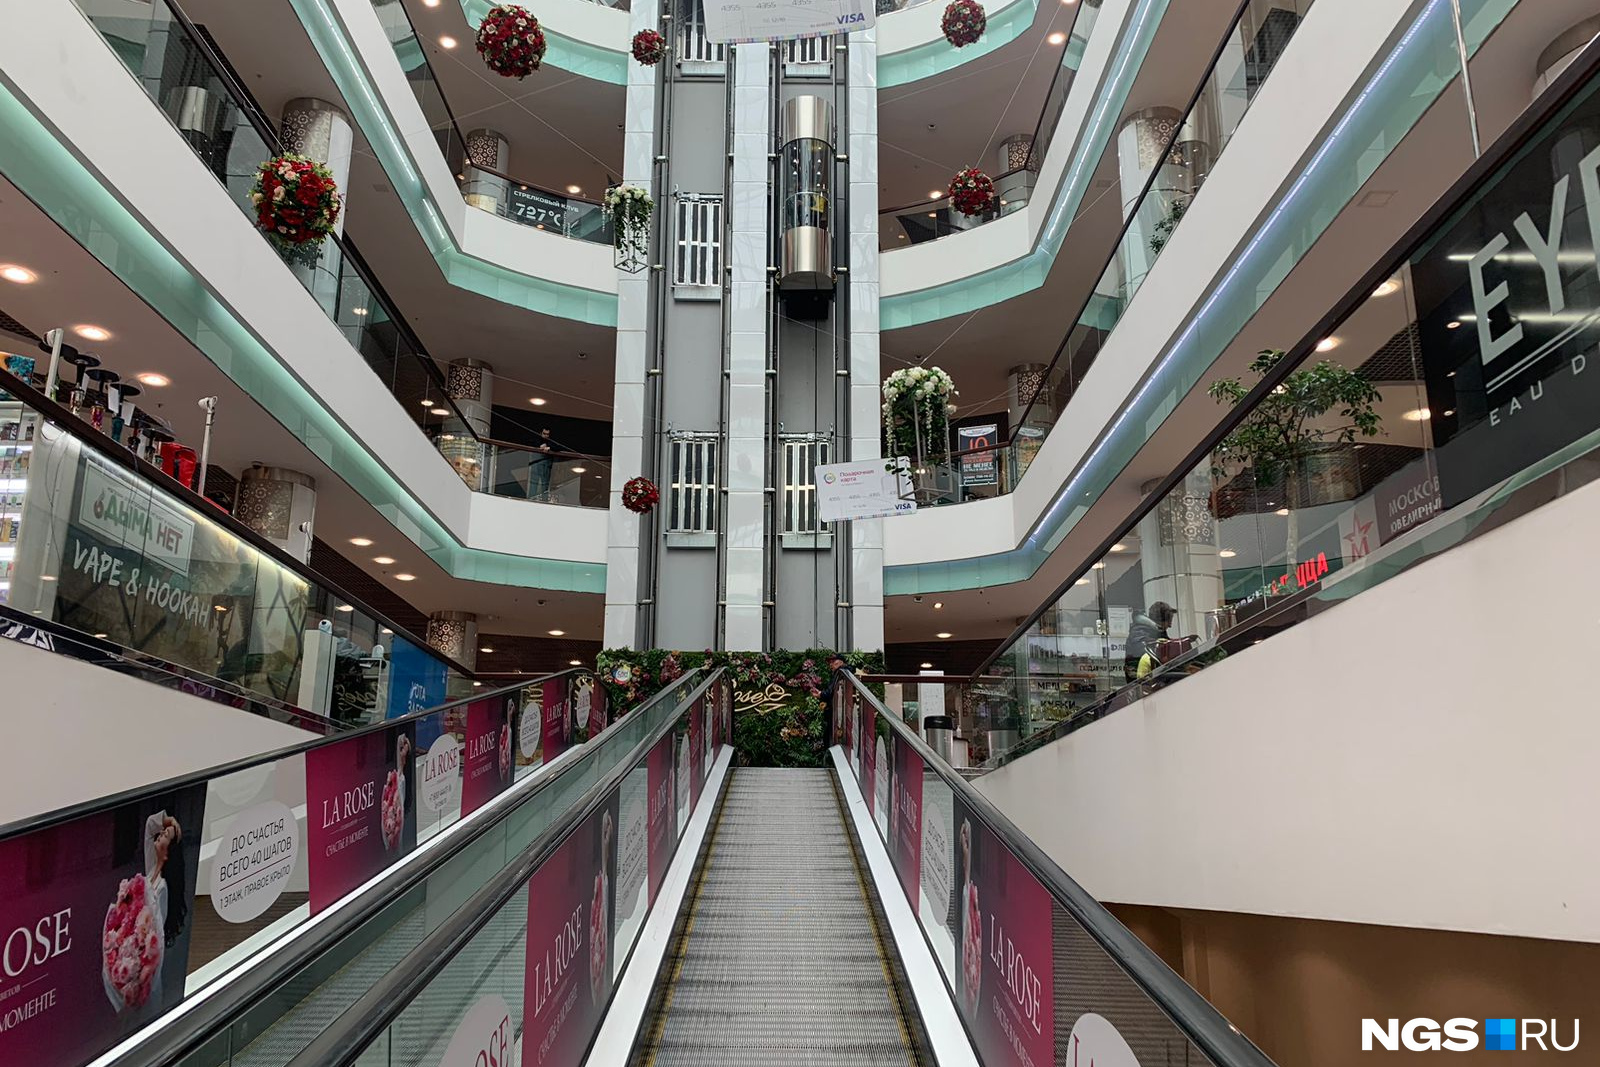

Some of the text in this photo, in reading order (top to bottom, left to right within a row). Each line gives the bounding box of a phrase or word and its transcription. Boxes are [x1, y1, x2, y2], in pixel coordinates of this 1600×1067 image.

[837, 12, 865, 24] VISA
[514, 190, 560, 208] СТРЕЛКОВЫЙ
[1490, 380, 1543, 426] EAU
[1388, 476, 1440, 517] МОСКОВ
[104, 494, 152, 541] ДЫМА
[156, 525, 183, 555] НЕТ
[73, 539, 211, 628] VAPE & HOOKAH
[1280, 551, 1328, 590] ПЦЦА
[425, 757, 436, 782] LA
[438, 747, 458, 776] ROSE
[469, 739, 479, 759] LA
[480, 731, 496, 755] ROSE
[322, 781, 374, 829] LA ROSE
[220, 836, 292, 882] ВСЕГО 40 ШАГОВ
[230, 818, 284, 856] ДО СЧАСТЬЯ
[244, 874, 270, 897] ПРАВОЕ
[270, 864, 291, 883] КРЫЛО
[0, 907, 72, 980] OSE
[534, 949, 552, 1018] LA
[554, 904, 583, 986] ROSE
[990, 913, 1004, 977] LA
[1007, 937, 1041, 1035] ROSE
[0, 988, 56, 1033] МОМЕНТЕ
